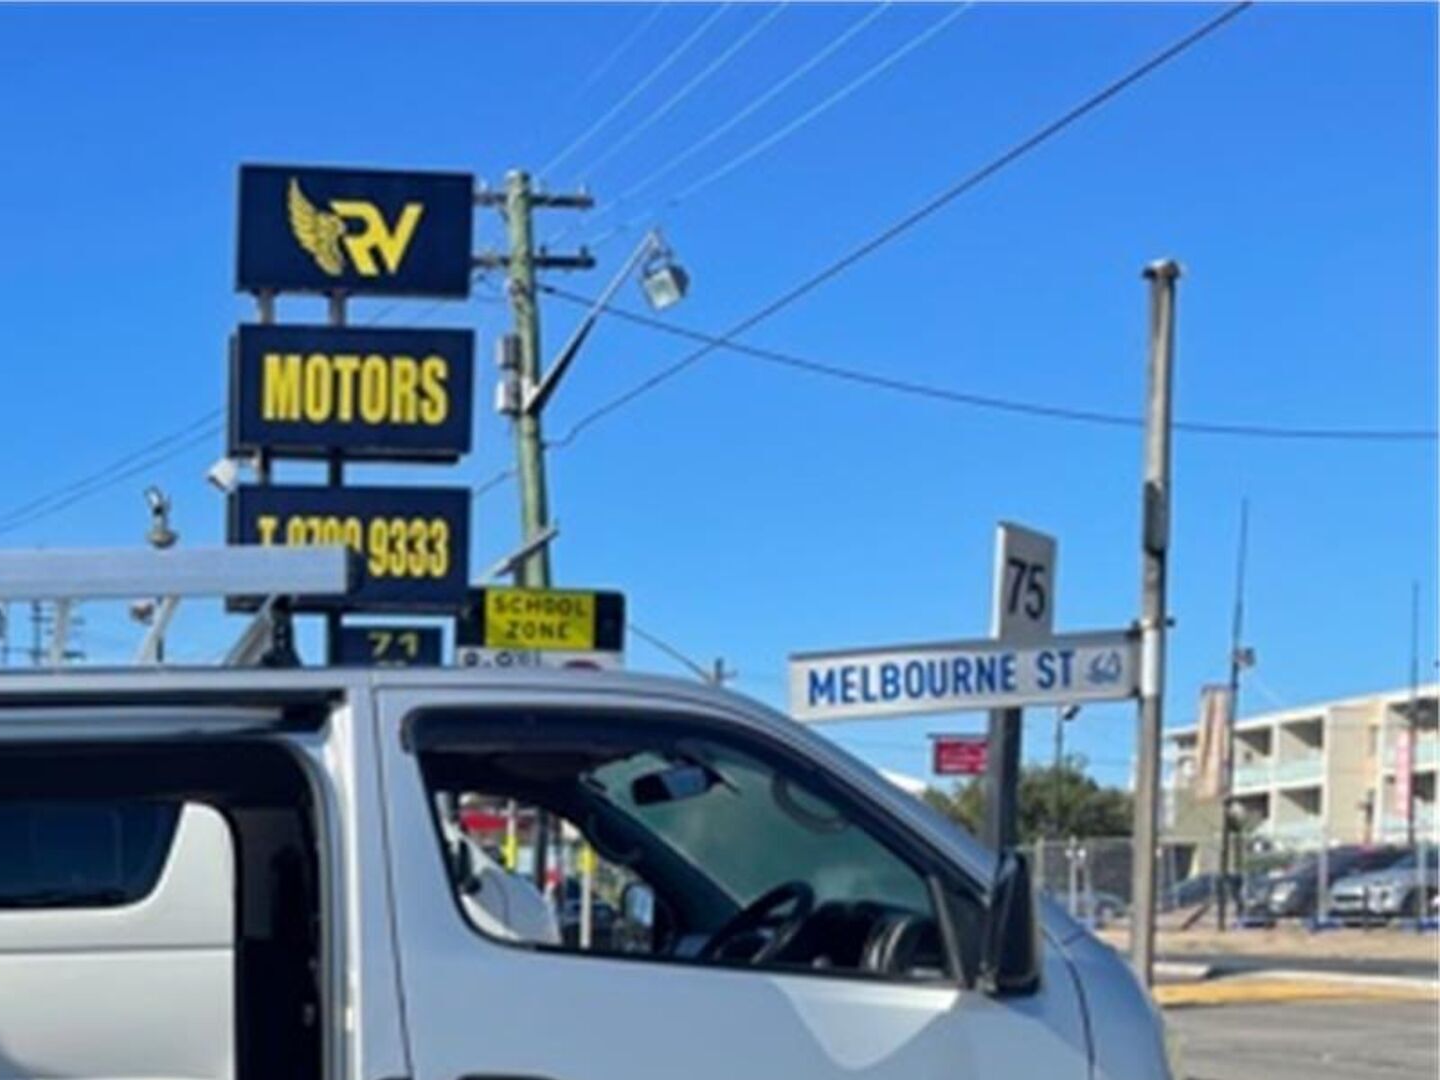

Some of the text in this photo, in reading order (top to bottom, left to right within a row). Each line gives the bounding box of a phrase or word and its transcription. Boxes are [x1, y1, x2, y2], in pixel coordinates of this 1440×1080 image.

[330, 201, 424, 275] RV
[262, 352, 449, 424] MOTORS
[368, 517, 449, 577] 9333
[494, 597, 588, 618] SCHOOL
[1007, 557, 1047, 620] 75
[505, 619, 571, 640] ZONE
[807, 650, 1076, 708] MELBOURNE ST
